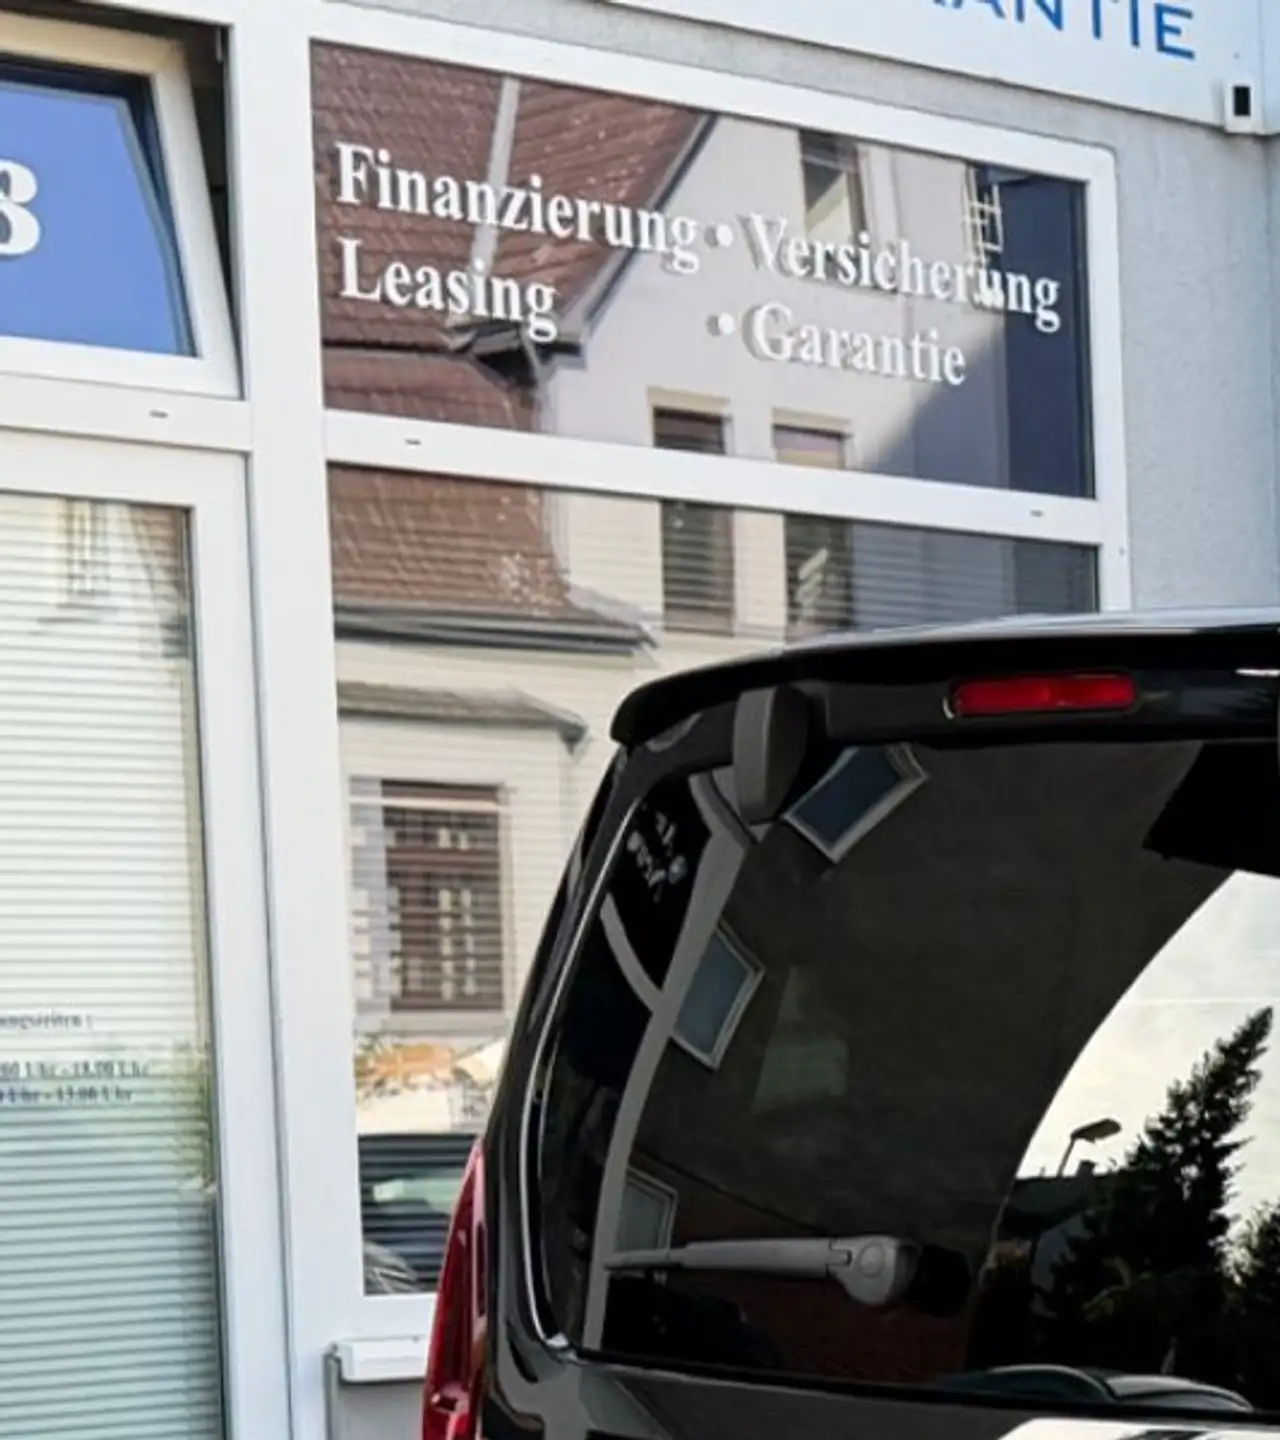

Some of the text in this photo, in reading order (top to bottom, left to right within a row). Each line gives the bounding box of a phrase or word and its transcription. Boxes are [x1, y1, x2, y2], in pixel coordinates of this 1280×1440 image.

[334, 140, 1062, 334] Finanzierung Versicherung
[336, 235, 559, 344] Leasing
[750, 300, 968, 387] Garantie
